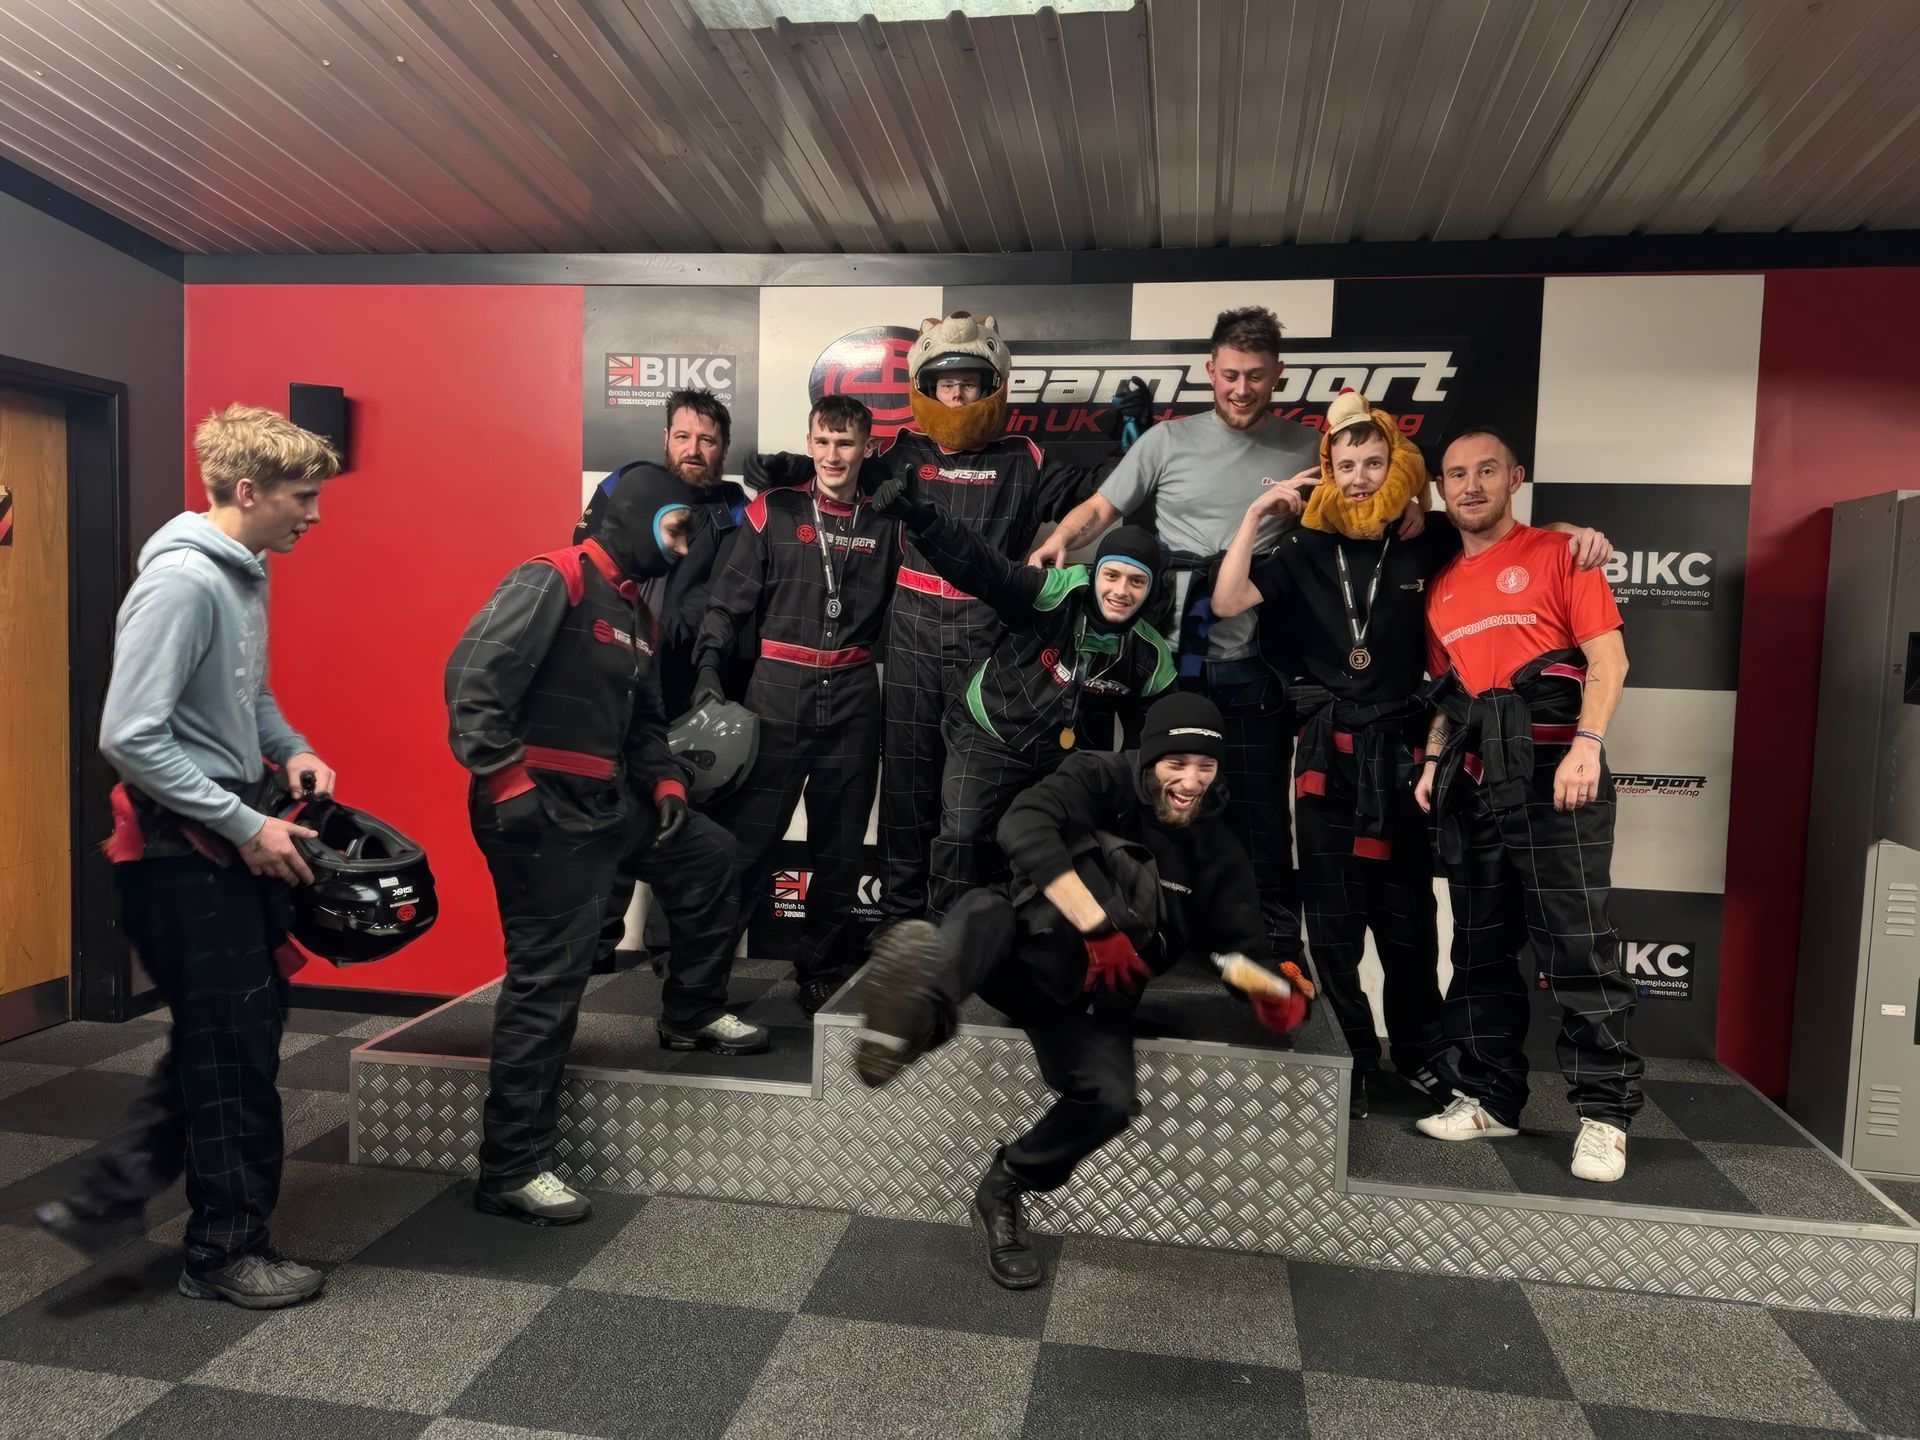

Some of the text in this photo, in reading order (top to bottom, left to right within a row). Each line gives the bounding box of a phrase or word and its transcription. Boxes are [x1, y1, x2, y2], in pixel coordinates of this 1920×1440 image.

[639, 357, 732, 389] BIKC
[1005, 409, 1038, 432] in
[1044, 408, 1108, 432] UK
[1601, 551, 1712, 586] BIKC
[1618, 941, 1690, 978] KC
